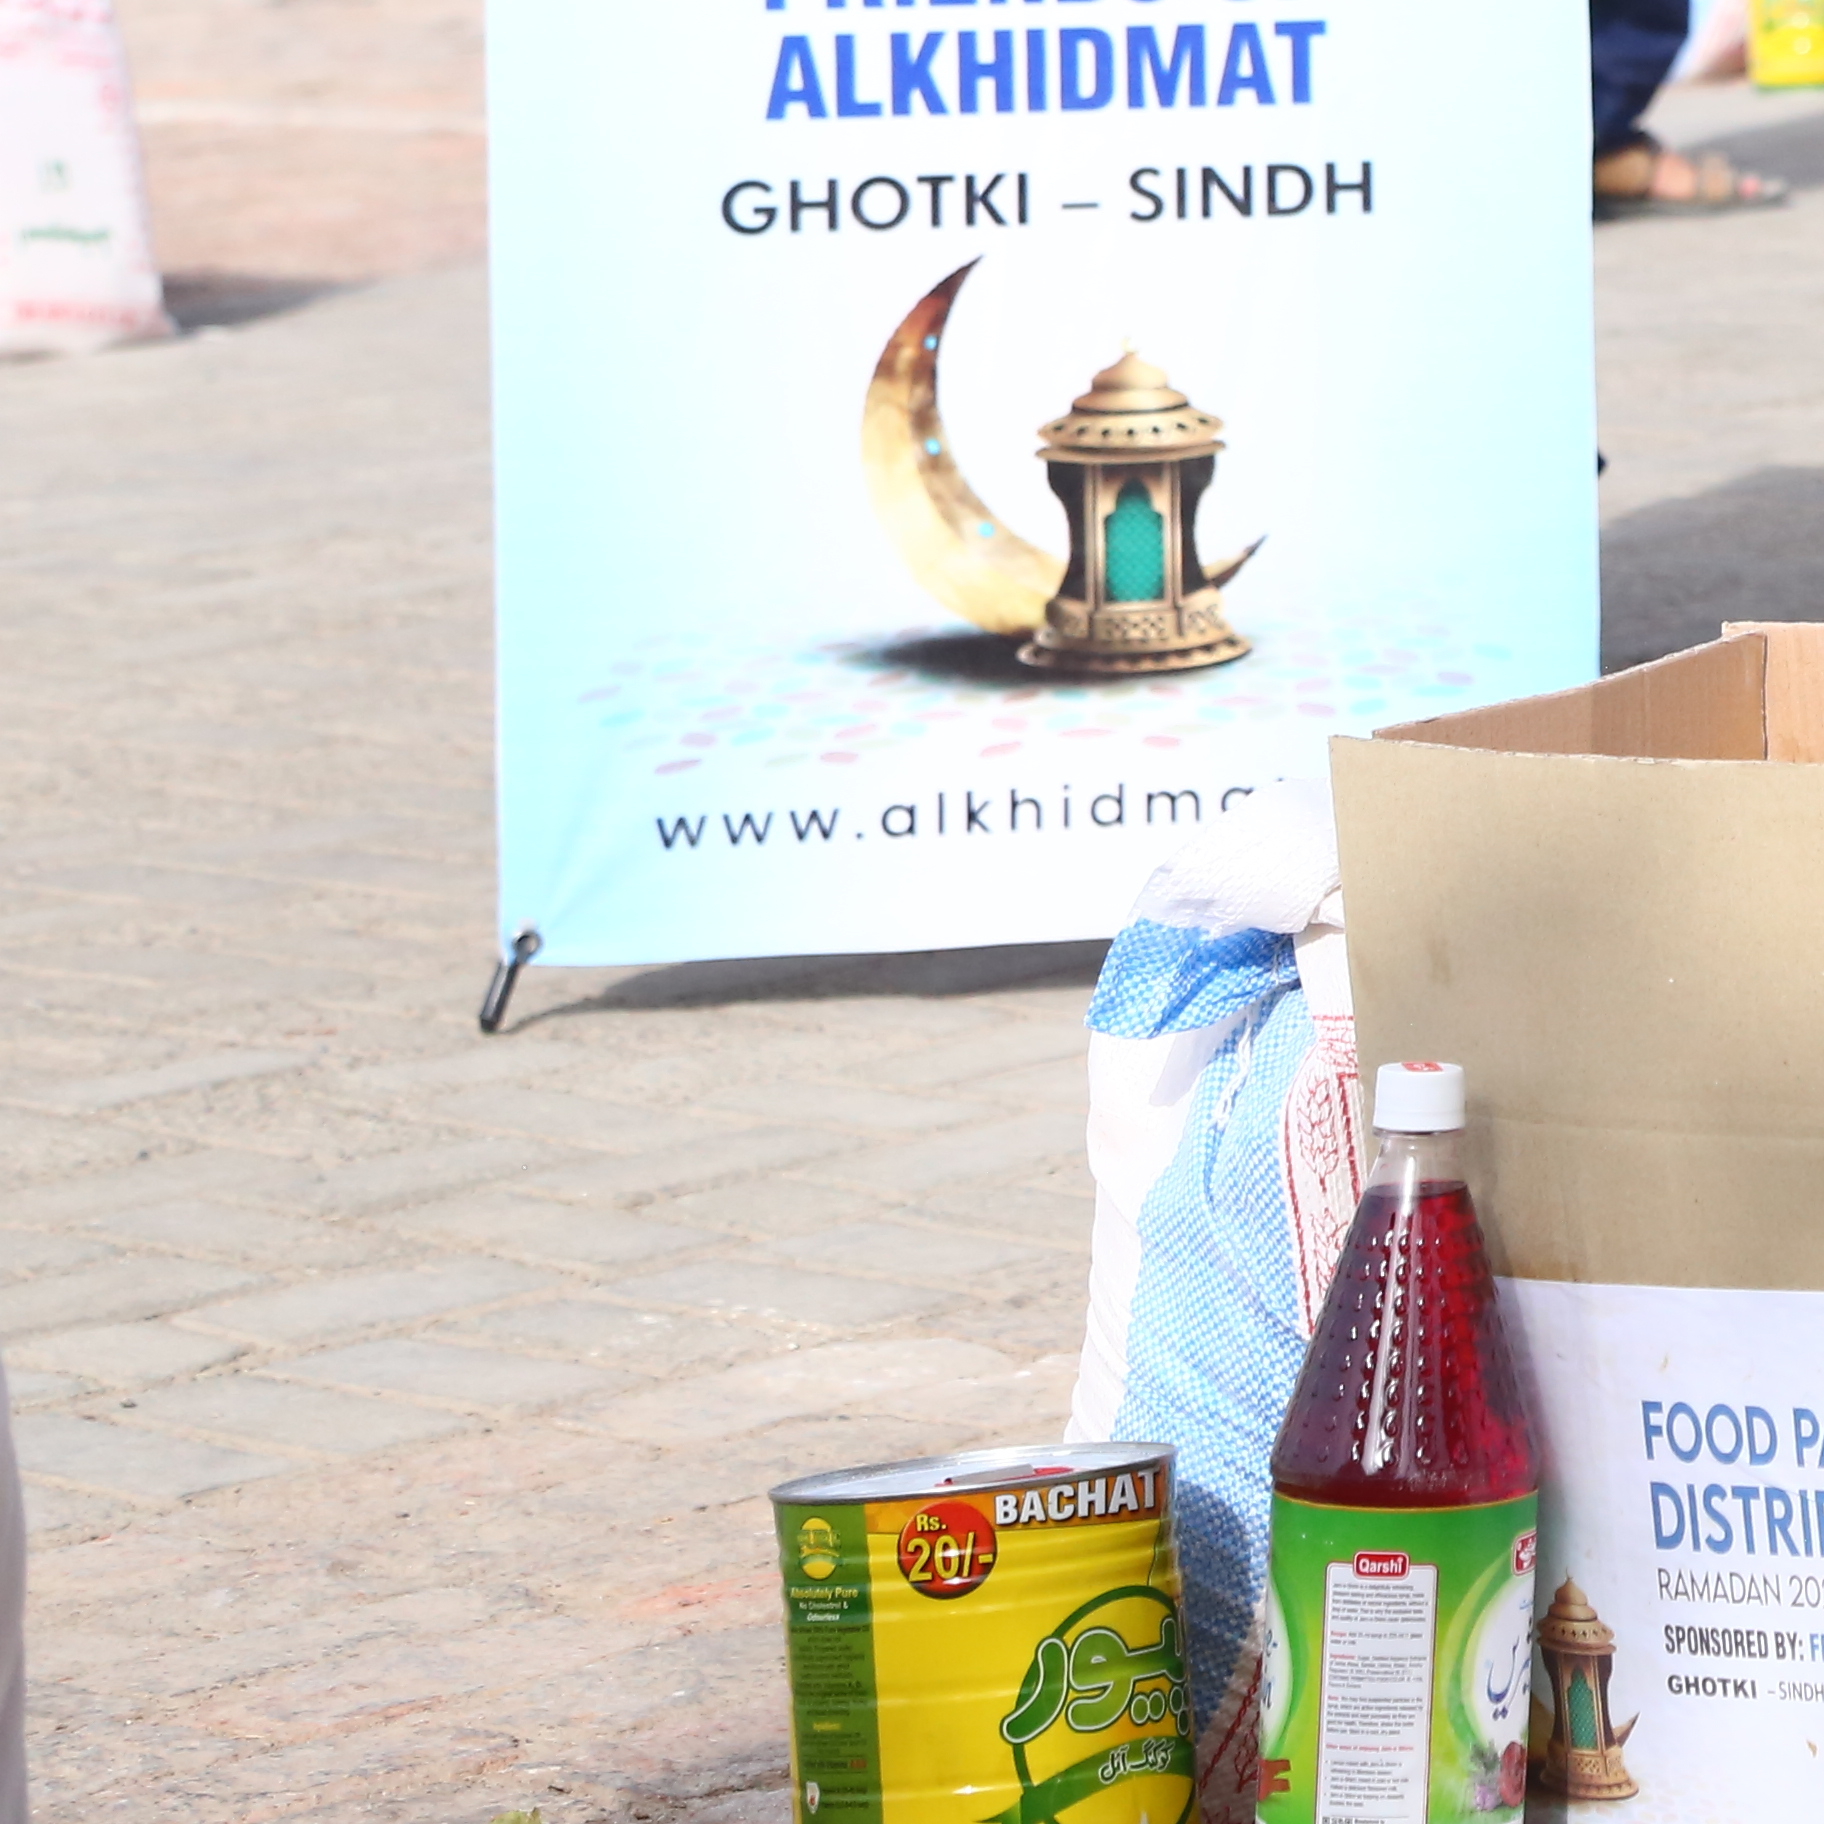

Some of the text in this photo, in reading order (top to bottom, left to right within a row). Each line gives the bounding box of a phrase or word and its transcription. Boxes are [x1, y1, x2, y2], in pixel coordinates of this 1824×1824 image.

[765, 19, 1327, 121] ALKHIDMAT
[721, 172, 1029, 236] GHOTKI
[1128, 160, 1374, 223] SINDH
[655, 774, 1257, 851] www.alkhidma
[1641, 1399, 1778, 1466] FOOD
[995, 1468, 1160, 1526] BACHAT
[916, 1514, 947, 1532] Rs.
[906, 1531, 993, 1583] 20/-
[1359, 1556, 1403, 1574] Qarshi
[835, 1586, 859, 1598] Pure
[1657, 1566, 1781, 1605] RAMADAN
[1664, 1623, 1769, 1659] SPONSORED
[1774, 1631, 1804, 1662] BY:
[1667, 1674, 1757, 1699] GHOTKI
